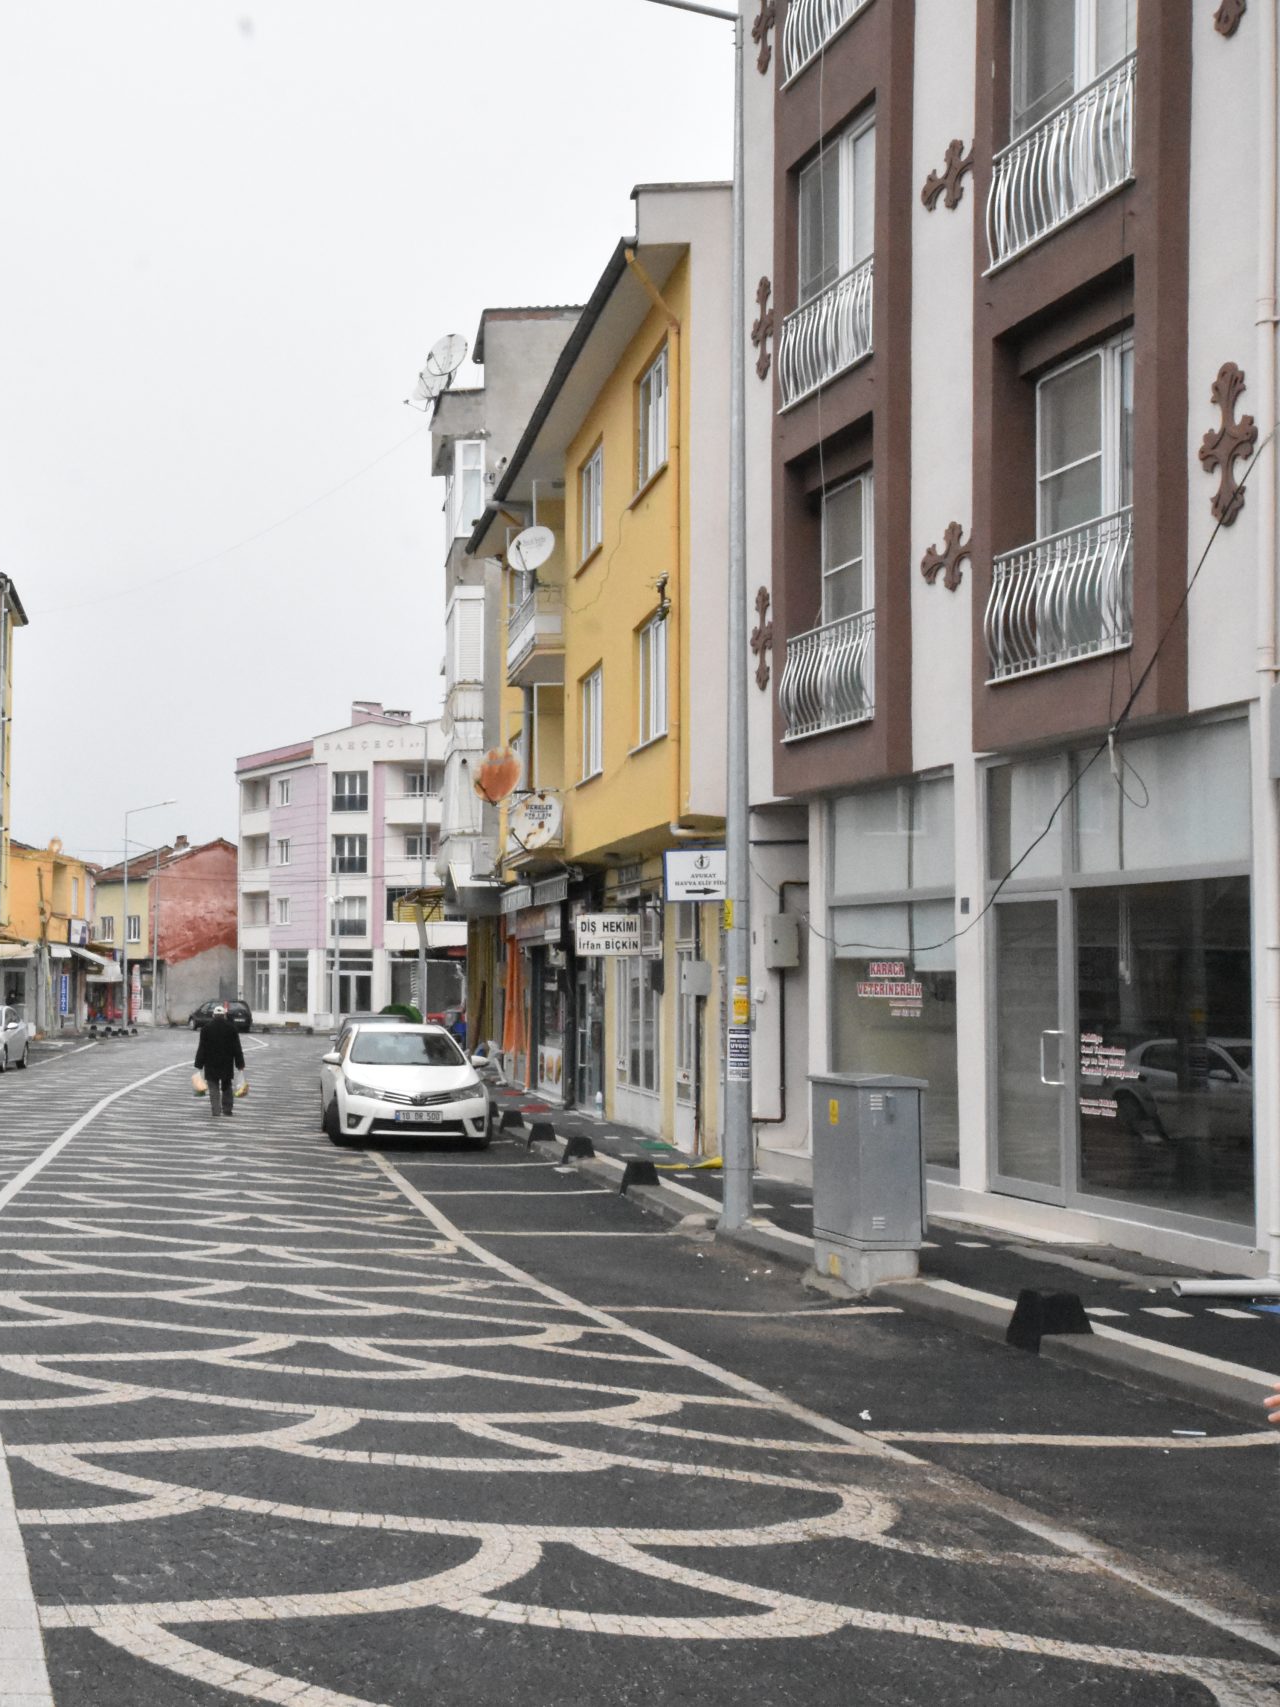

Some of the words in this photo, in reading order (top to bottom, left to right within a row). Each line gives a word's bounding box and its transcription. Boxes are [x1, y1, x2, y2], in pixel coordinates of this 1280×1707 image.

[580, 918, 597, 935] DİŞ
[602, 918, 638, 933] HEKİMİ
[578, 937, 601, 950] İrfan
[604, 938, 639, 951] BİÇKİN
[869, 961, 906, 978] KARACA
[856, 978, 923, 999] VETERİNERLİK
